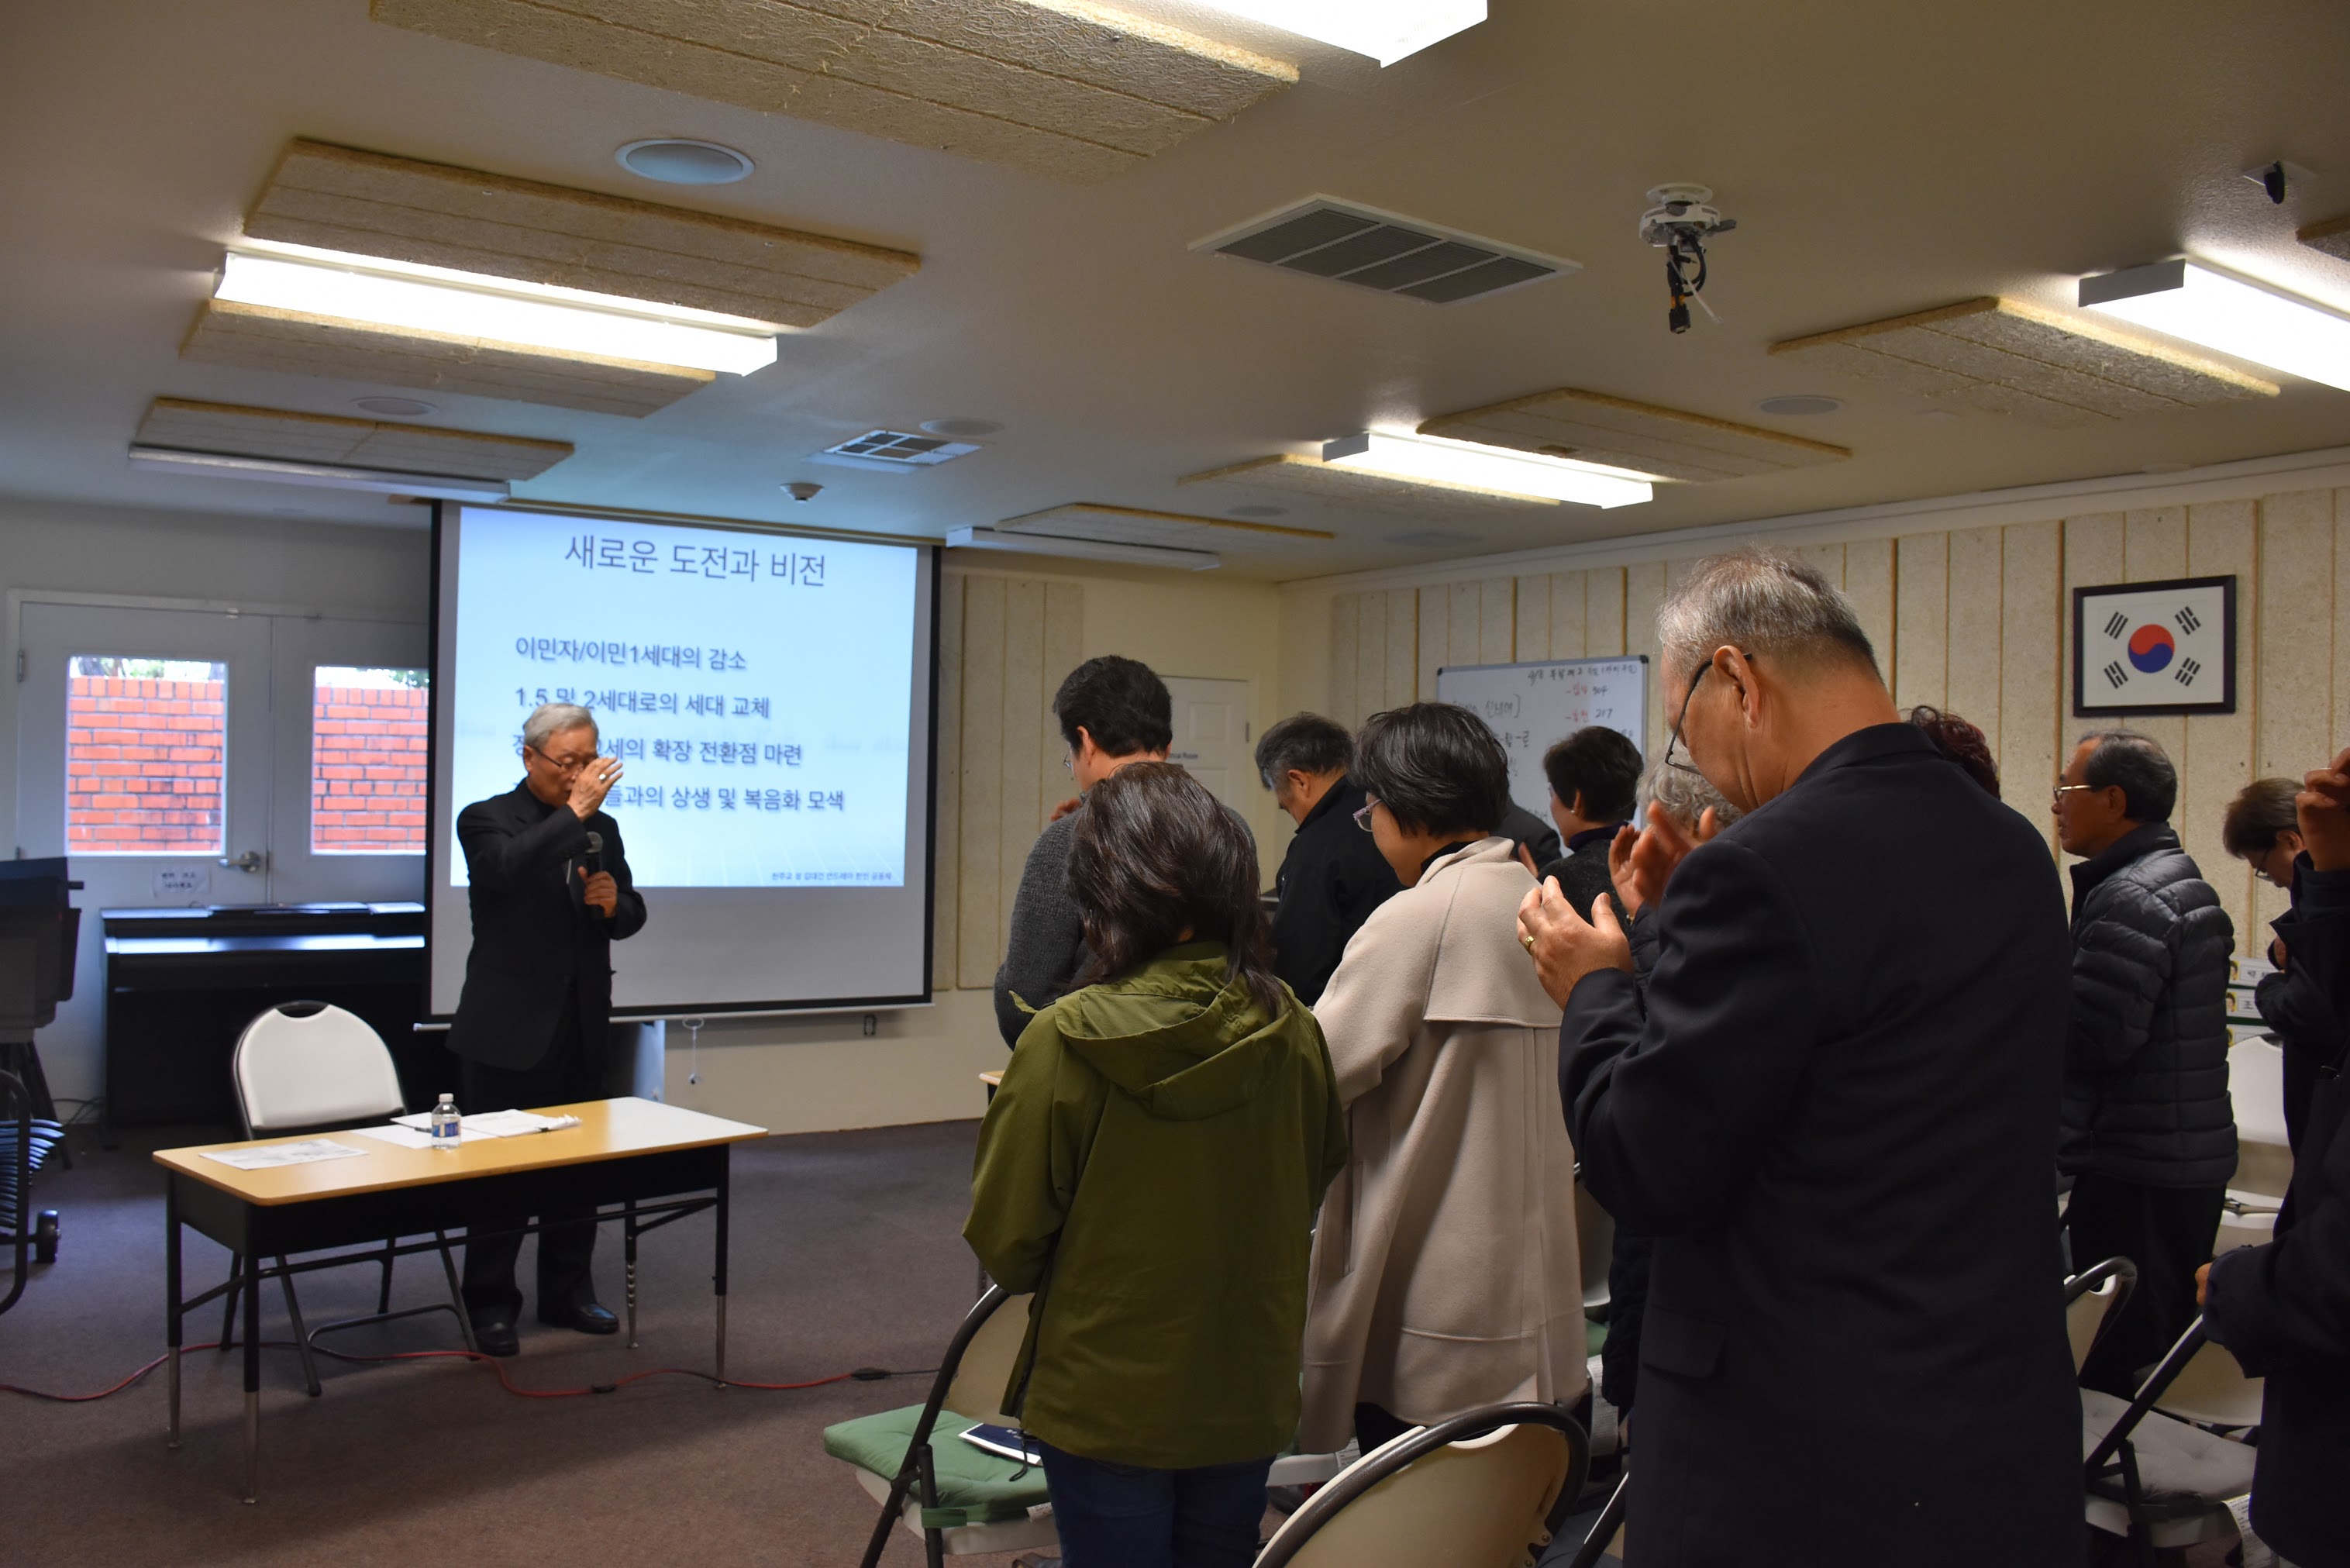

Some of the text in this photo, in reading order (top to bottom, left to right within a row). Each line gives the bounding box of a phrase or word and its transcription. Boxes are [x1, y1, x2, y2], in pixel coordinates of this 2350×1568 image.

[565, 534, 825, 587] 새로운 도전과 비전
[516, 636, 747, 670] 이민자/이민1세대의 감소
[515, 687, 548, 707] 1.5
[584, 689, 677, 714] 2세대로의
[685, 694, 724, 718] 세대
[731, 697, 770, 719] 교체
[653, 738, 691, 762] 확장
[700, 741, 756, 764] 전환점
[764, 744, 801, 766] 마련
[671, 785, 711, 809] 상생
[718, 787, 736, 810] 및
[743, 788, 800, 811] 복음화
[807, 790, 843, 812] 모색
